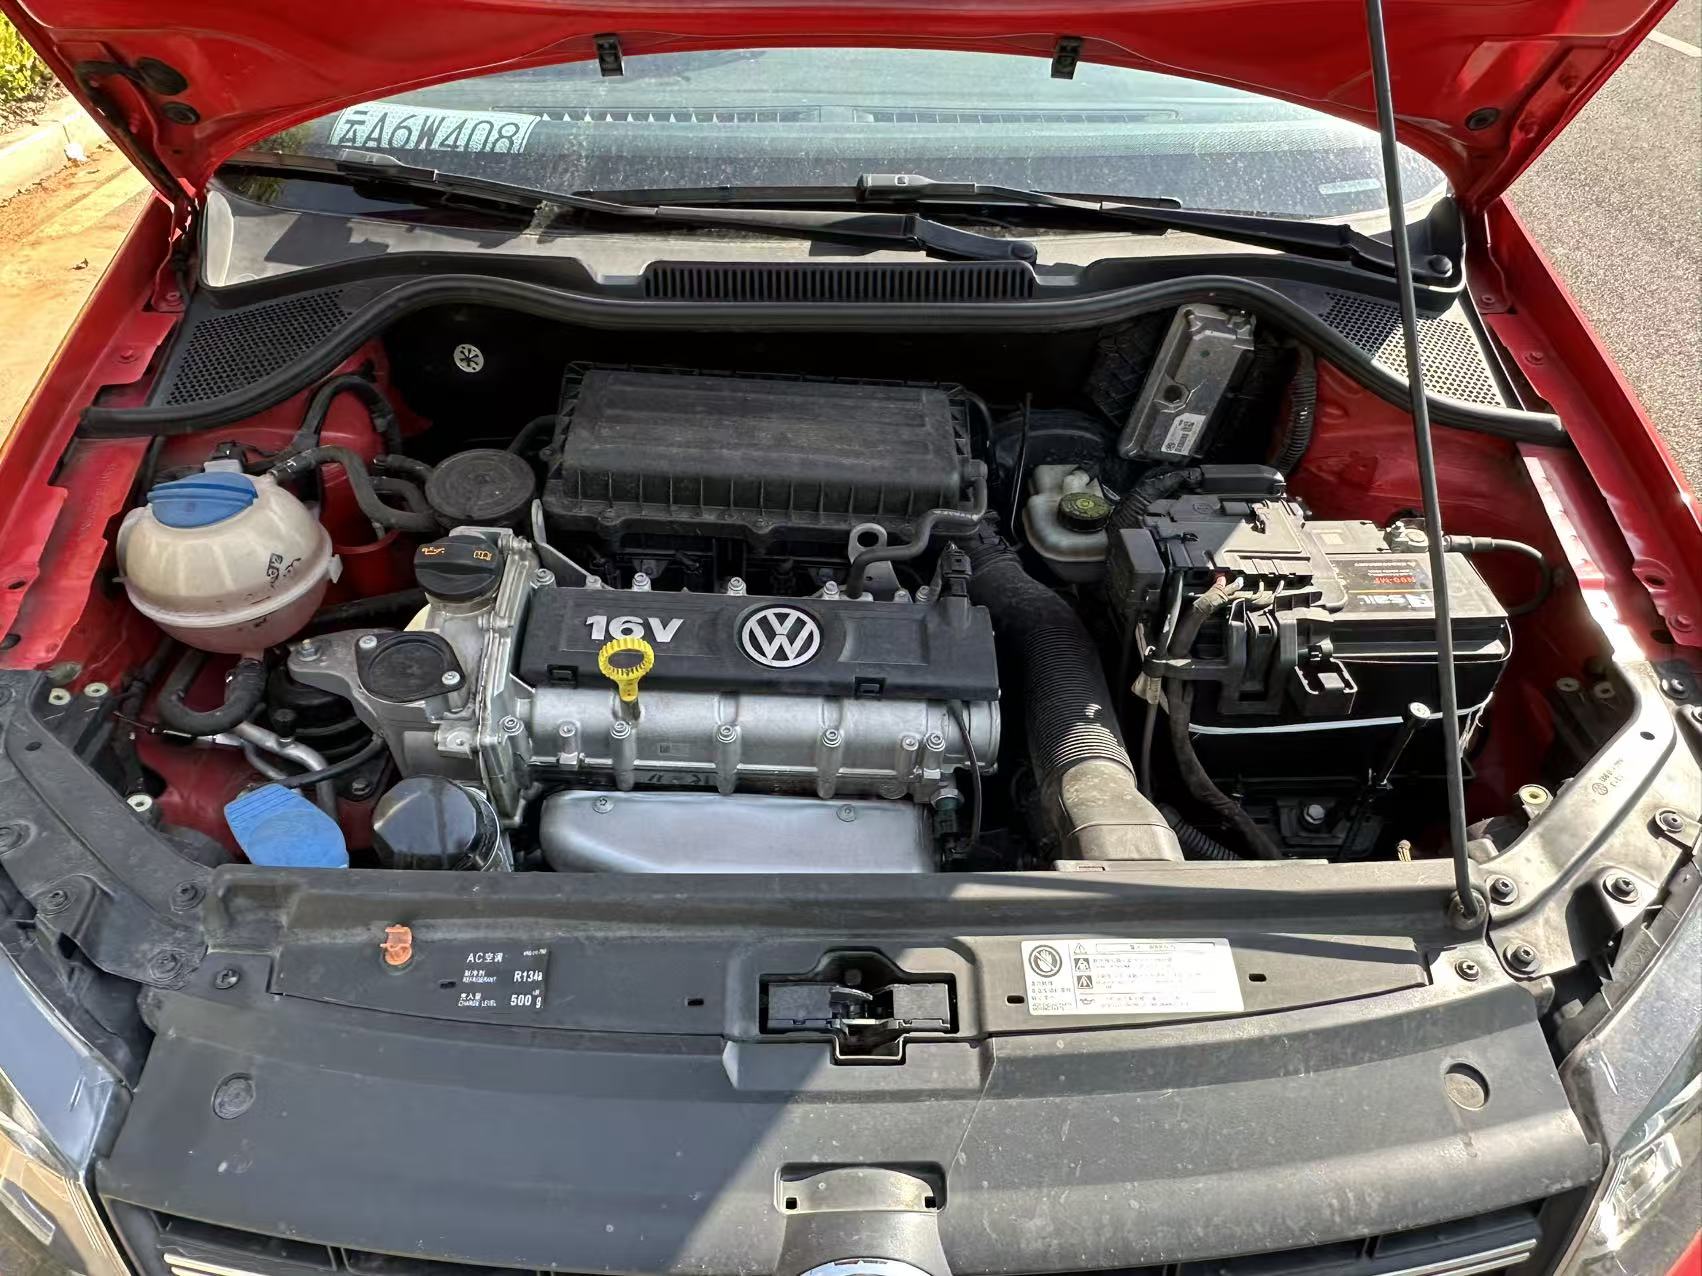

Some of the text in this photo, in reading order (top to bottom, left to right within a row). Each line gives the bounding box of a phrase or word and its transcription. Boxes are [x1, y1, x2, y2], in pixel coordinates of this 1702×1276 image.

[585, 615, 685, 642] 16V
[514, 971, 543, 983] R134a
[510, 995, 532, 1006] 500
